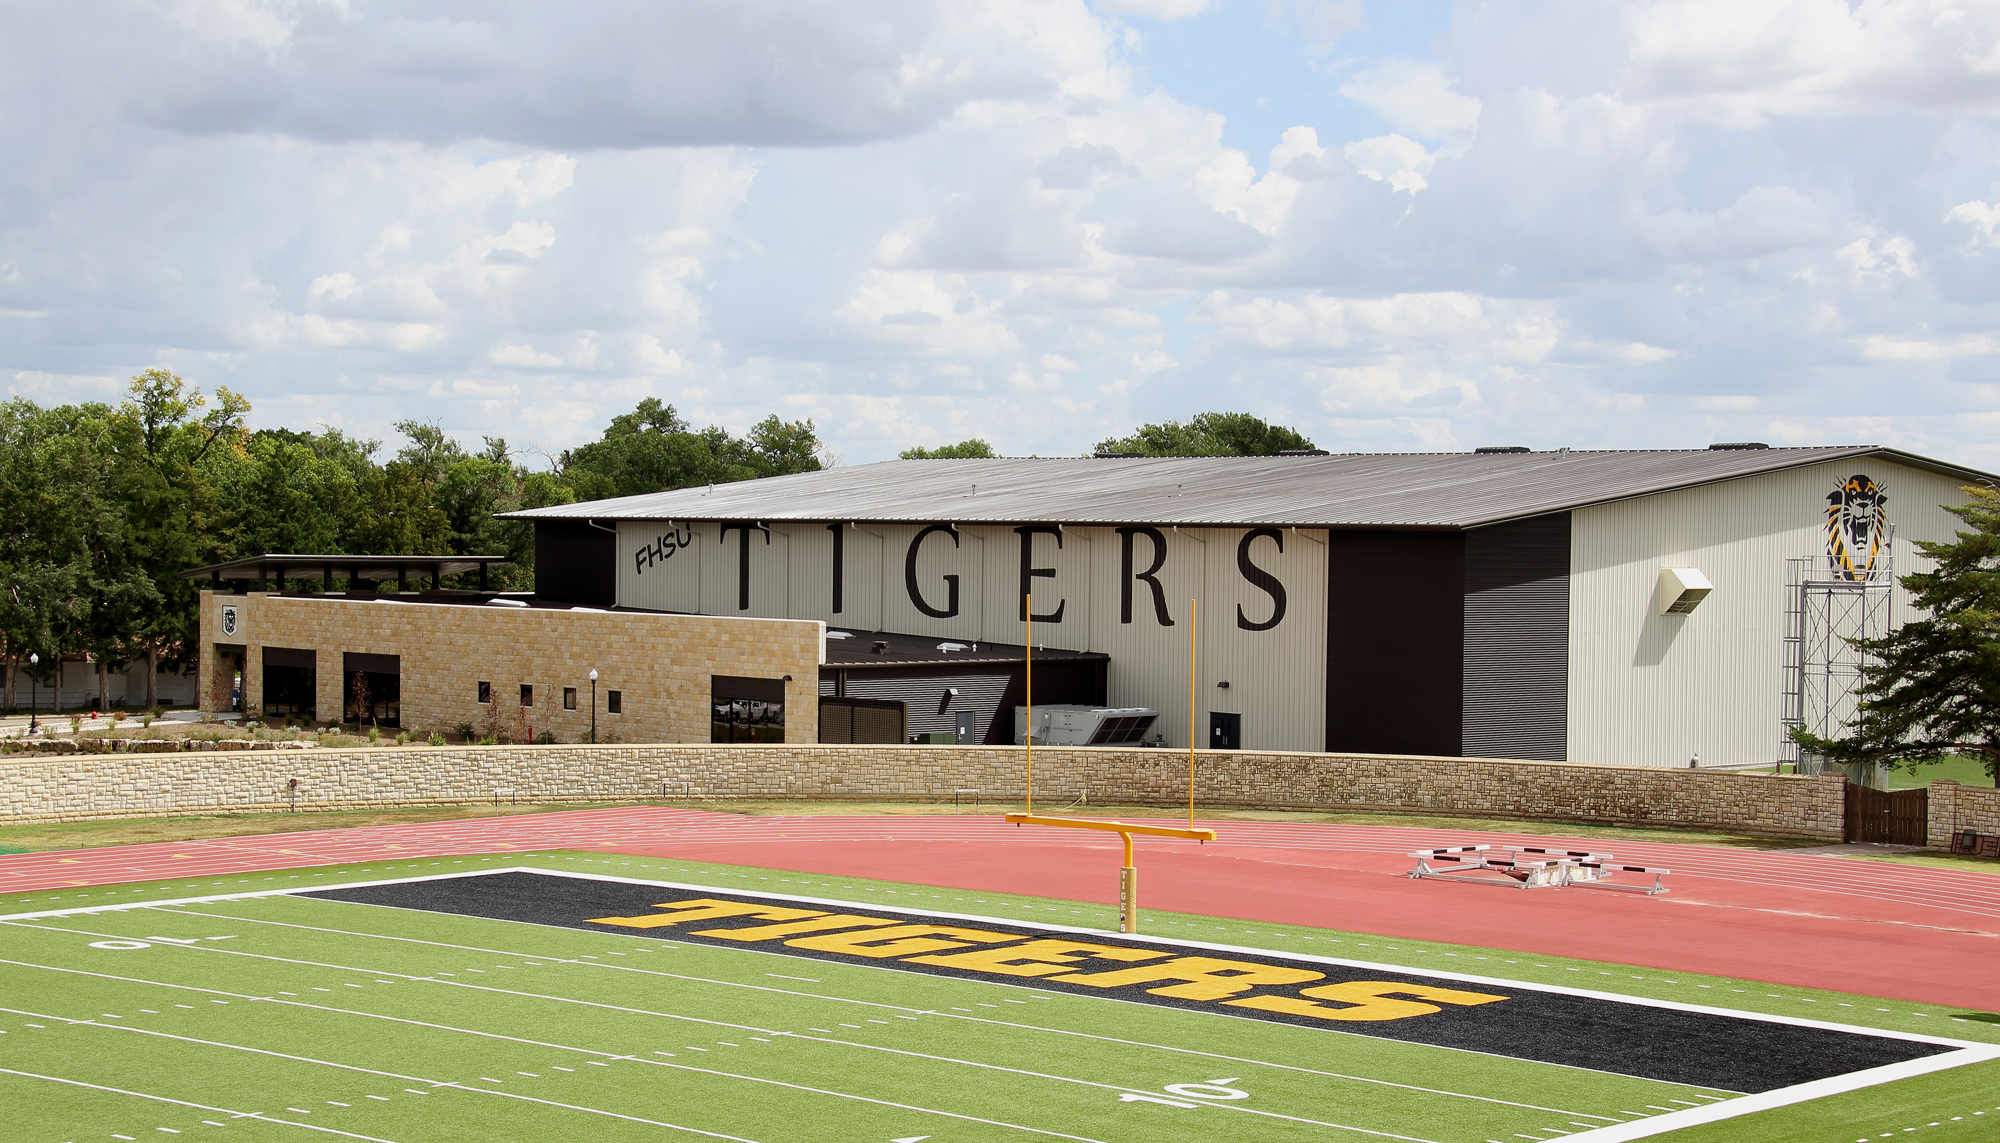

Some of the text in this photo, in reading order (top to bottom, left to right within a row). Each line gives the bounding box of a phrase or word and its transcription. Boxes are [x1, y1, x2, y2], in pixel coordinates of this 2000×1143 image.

[635, 522, 692, 575] FHSU
[719, 523, 1287, 631] TIGERS
[582, 898, 1512, 1022] TIGERS
[1118, 1083, 1250, 1109] 10
